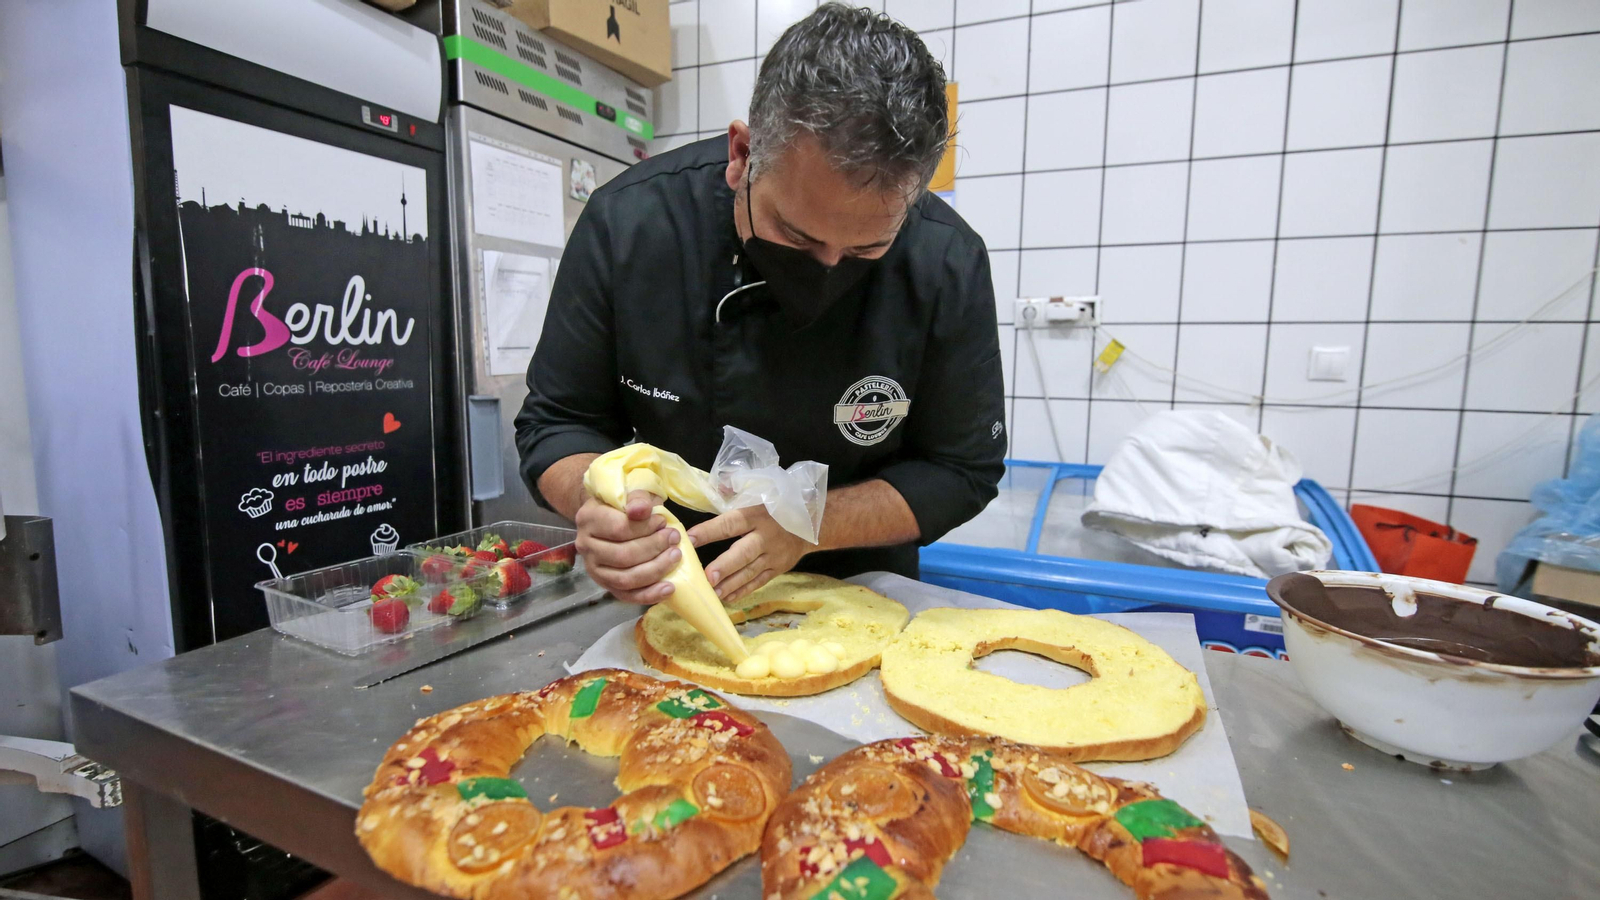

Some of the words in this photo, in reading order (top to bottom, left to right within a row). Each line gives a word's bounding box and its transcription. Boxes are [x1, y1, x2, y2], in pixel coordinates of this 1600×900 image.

[211, 267, 415, 363] Berlin
[288, 347, 333, 376] Café
[335, 347, 394, 374] Lounge
[219, 381, 251, 398] Café
[263, 381, 305, 397] Copas
[315, 379, 373, 394] Repostería
[375, 378, 414, 391] Creativa
[626, 379, 651, 396] Carlos
[653, 387, 680, 402] Ibáñez
[851, 404, 893, 422] Berlin
[276, 445, 343, 465] ingrediente
[345, 439, 385, 454] secreto
[272, 471, 300, 488] en
[303, 461, 339, 483] todo
[341, 455, 388, 488] postre
[285, 496, 306, 511] es
[317, 483, 383, 507] siempre
[275, 518, 300, 531] una
[301, 508, 353, 527] cucharada
[353, 503, 365, 516] de
